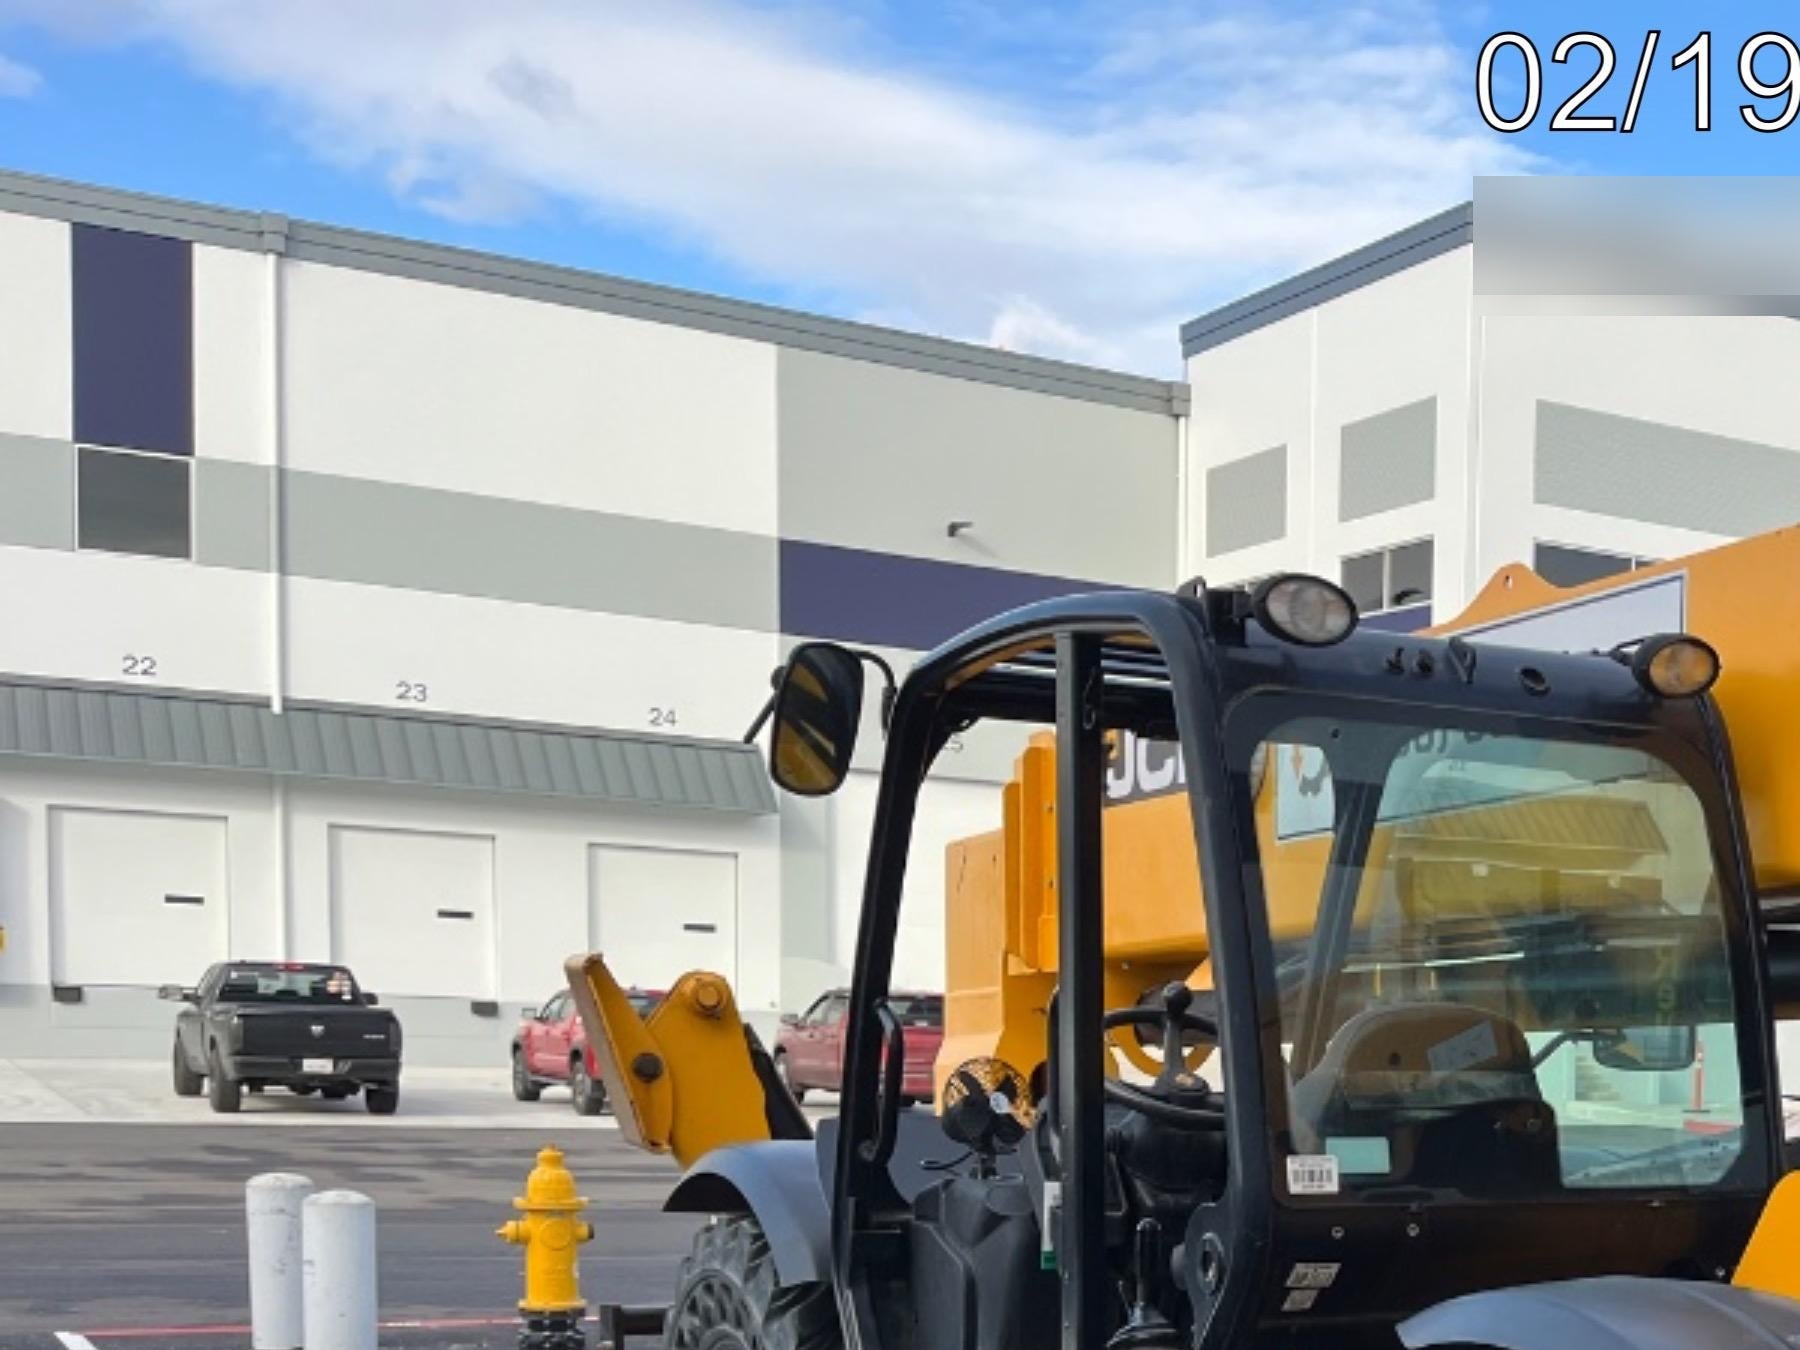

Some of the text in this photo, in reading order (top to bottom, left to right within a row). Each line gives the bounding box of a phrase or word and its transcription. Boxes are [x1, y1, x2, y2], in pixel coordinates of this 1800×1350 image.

[122, 654, 157, 676] 22
[395, 680, 427, 702] 23
[648, 706, 679, 727] 24
